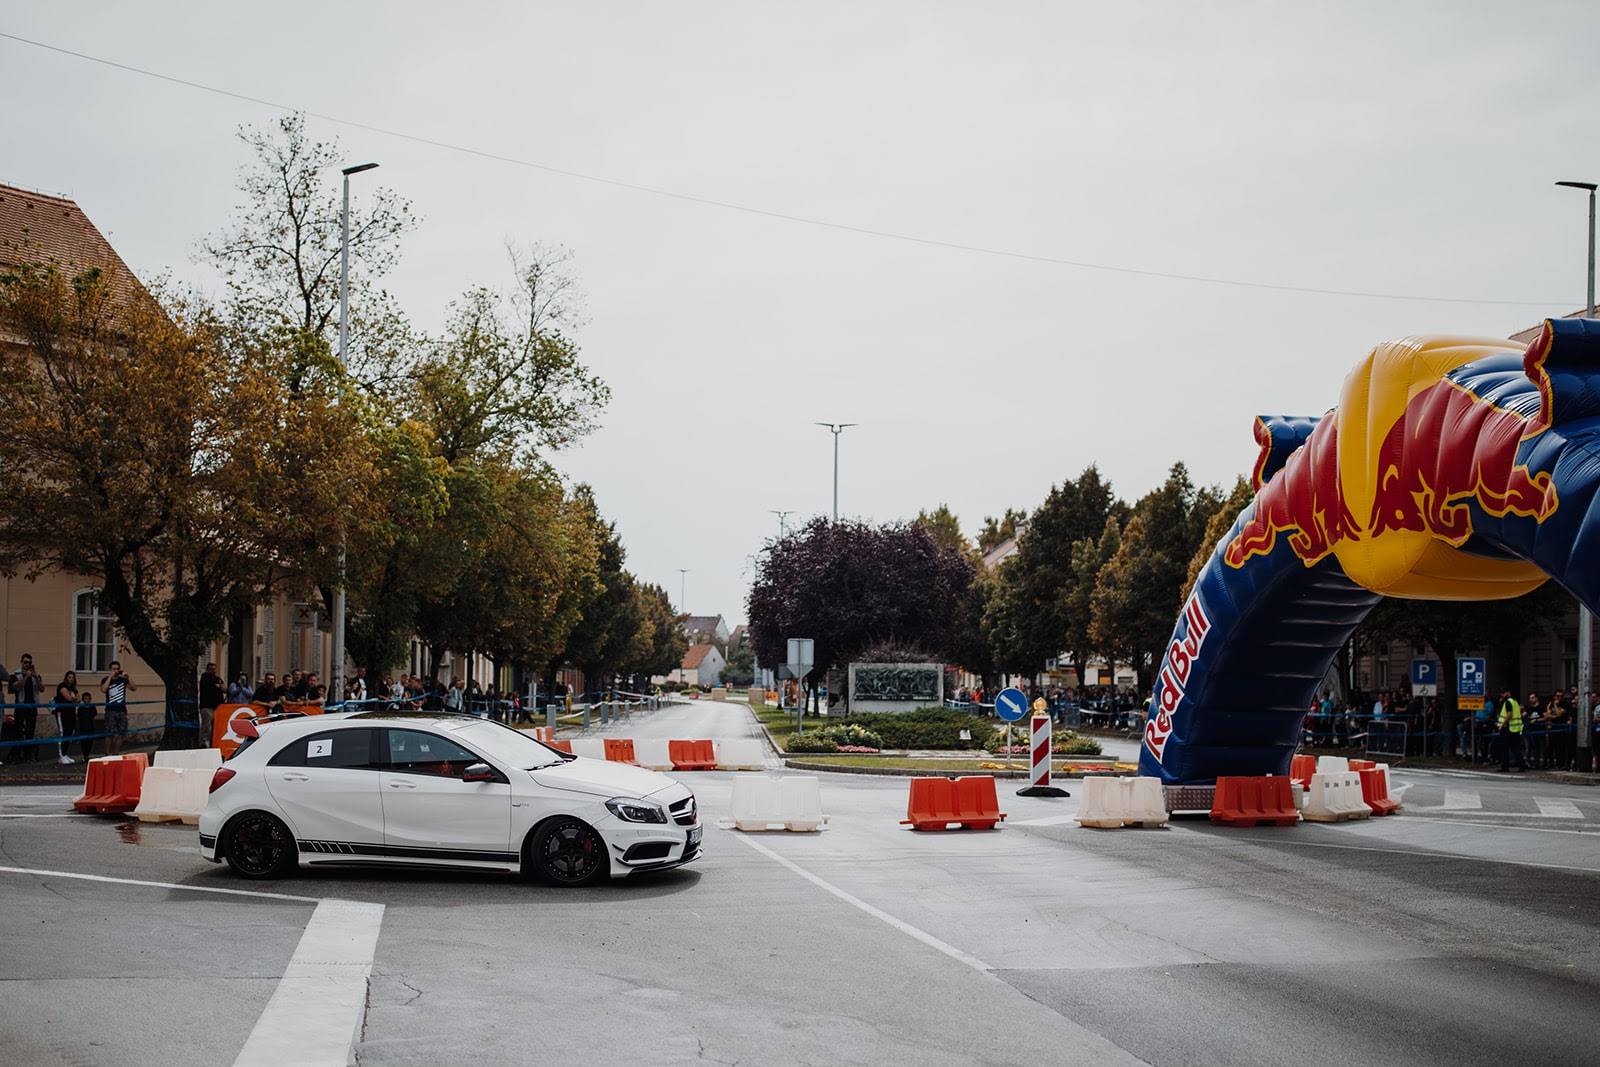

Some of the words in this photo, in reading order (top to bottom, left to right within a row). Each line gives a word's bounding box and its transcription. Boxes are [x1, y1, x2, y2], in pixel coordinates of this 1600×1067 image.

[1145, 666, 1183, 763] Red
[1168, 594, 1209, 687] Bull
[1419, 664, 1430, 680] P
[1462, 662, 1476, 679] P
[316, 745, 323, 754] 2
